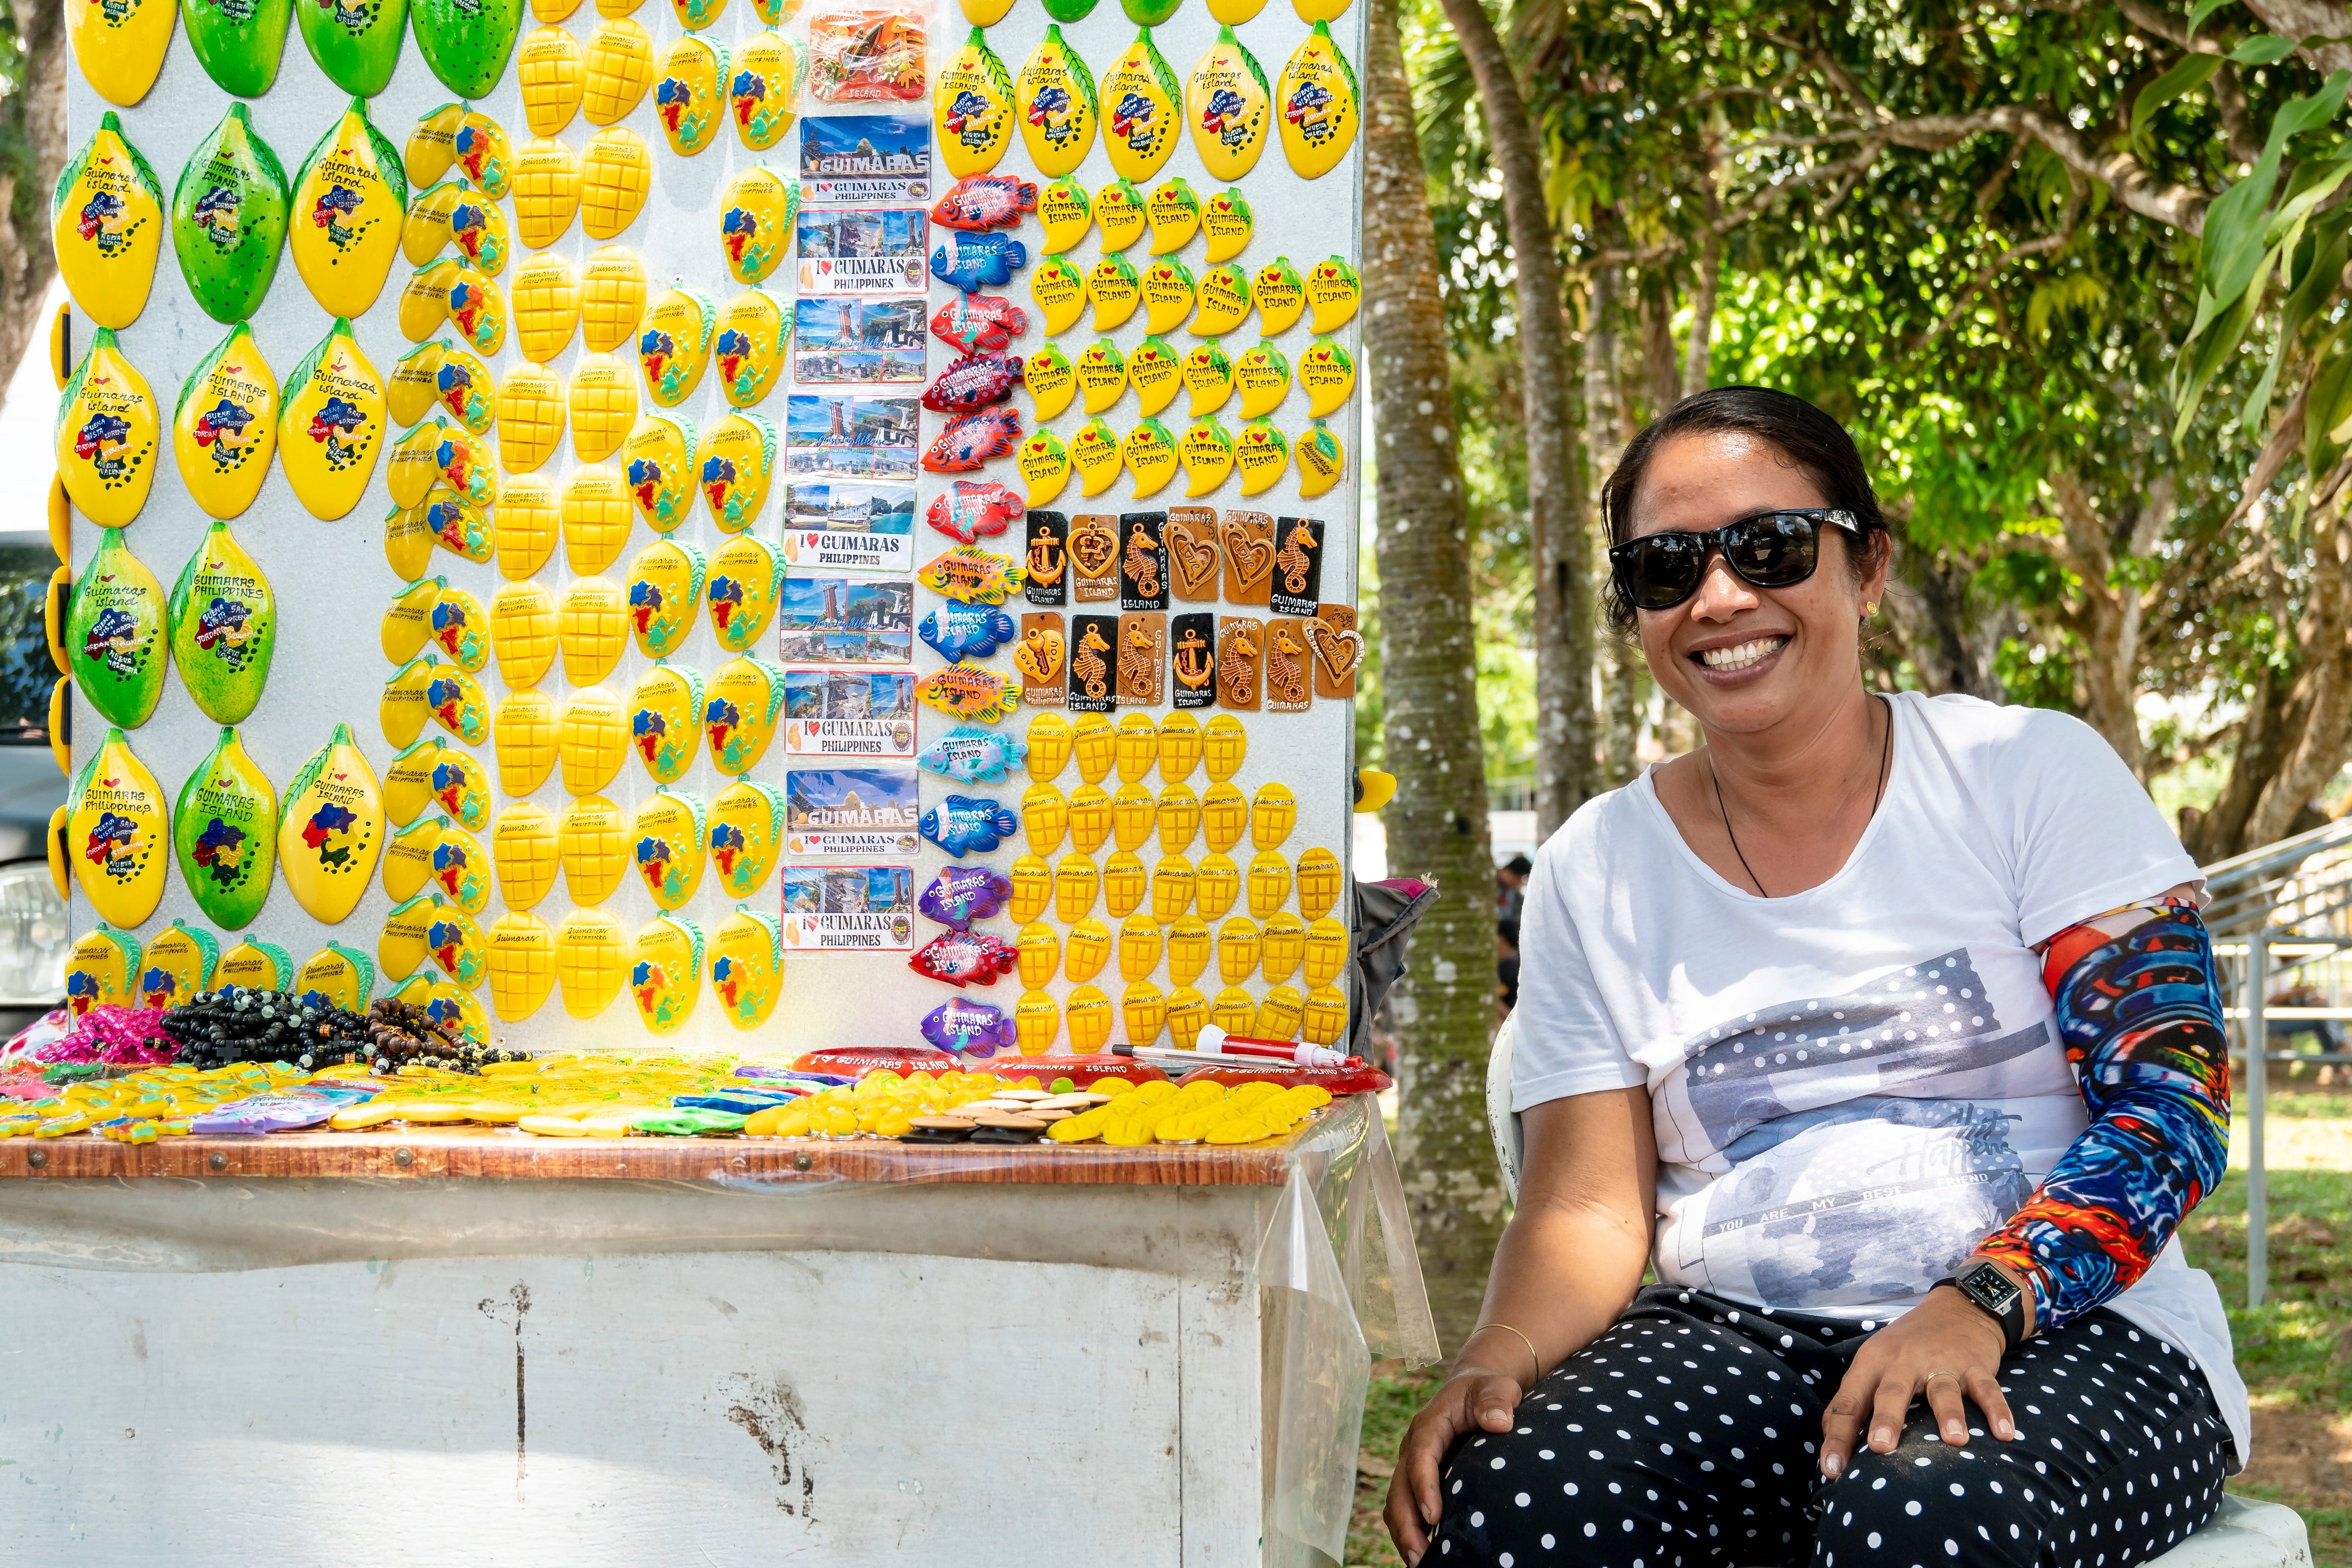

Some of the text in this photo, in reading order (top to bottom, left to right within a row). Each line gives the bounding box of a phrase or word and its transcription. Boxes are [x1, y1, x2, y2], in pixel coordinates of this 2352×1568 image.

[596, 33, 640, 44] Guimaras
[524, 43, 568, 56] Guimaras
[599, 41, 633, 50] PHILIPPINES
[528, 48, 566, 58] PHILIPPINES
[1021, 67, 1068, 77] Guimaras
[1285, 61, 1332, 74] Guimaras
[941, 71, 987, 83] GUIMARAS
[1194, 72, 1241, 82] Guimaras
[943, 83, 977, 91] ISLAND
[1285, 106, 1307, 119] JORDAN
[1049, 125, 1067, 133] NUEVA
[1306, 123, 1327, 131] NUEVA
[820, 154, 928, 171] GUIMARAS
[84, 166, 137, 184] Guimaras
[318, 158, 379, 182] Guimaras
[87, 180, 131, 193] island
[816, 183, 821, 192] I
[834, 182, 906, 192] GUIMARAS
[953, 186, 1004, 207] GUIMARAS
[961, 201, 999, 218] ISLAND
[1043, 201, 1087, 214] GUIMARAS
[1099, 202, 1143, 217] GUIMARAS
[1151, 201, 1195, 215] GUIMARAS
[1048, 213, 1081, 224] ISLAND
[1106, 216, 1137, 227] ISLAND
[1156, 213, 1190, 225] ISLAND
[1206, 214, 1250, 225] GUIMARAS
[1211, 226, 1244, 236] ISLAND
[945, 245, 997, 259] GUIMARAS
[817, 260, 821, 275] I
[835, 259, 904, 275] GUIMARAS
[948, 258, 987, 270] ISLAND
[834, 279, 893, 290] PHILIPPINES
[1036, 278, 1078, 295] GUIMARAS
[1311, 278, 1357, 291] GUIMARAS
[1044, 293, 1075, 306] ISLAND
[1316, 293, 1352, 304] ISLAND
[950, 308, 1003, 321] GUIMARAS
[951, 320, 989, 333] ISLAND
[850, 335, 896, 351] Lighthouse
[939, 361, 993, 389] GUIMARAS
[1081, 363, 1124, 375] GUIMARAS
[1304, 364, 1352, 375] GUIMARAS
[207, 373, 267, 397] GUIMARAS
[313, 370, 378, 395] Guimaras
[1088, 378, 1120, 388] ISLAND
[1309, 376, 1343, 386] ISLAND
[210, 385, 254, 403] ISLAND
[947, 376, 993, 401] ISLAND
[80, 387, 143, 404] Guimaras
[88, 401, 130, 413] island
[193, 430, 218, 438] JORDAN
[626, 426, 671, 446] Guimaras
[75, 442, 97, 452] JORDAN
[629, 435, 666, 452] PHILIPPINES
[1238, 444, 1284, 458] GUIMARAS
[97, 460, 118, 469] NUEVA
[1244, 455, 1278, 470] ISLAND
[1169, 513, 1211, 523] GUIMARAS
[1226, 511, 1268, 524] GUIMARAS
[800, 534, 899, 552] I GUIMARAS
[712, 550, 765, 561] Guimaras
[819, 553, 880, 565] PHILIPPINES
[1158, 522, 1168, 590] GUIMARAS
[944, 560, 991, 574] GUIMARAS
[194, 574, 255, 587] GUIMARAS
[944, 574, 983, 586] ISLAND
[1075, 577, 1118, 588] GUIMARAS
[194, 587, 264, 599] PHILIPPINES
[1026, 586, 1061, 596] GUIMARAS
[1084, 587, 1114, 596] ISLAND
[1031, 596, 1054, 604] ISLAND
[1122, 599, 1160, 609] ISLAND
[1271, 593, 1318, 609] GUIMARAS
[231, 605, 247, 613] SAN
[1278, 605, 1313, 615] ISLAND
[835, 616, 880, 632] Lighthouse
[1219, 620, 1258, 639] GUIMARAS
[196, 628, 222, 644] JORDAN
[1303, 625, 1324, 659] ISLAND
[1050, 640, 1058, 663] YOU
[1340, 630, 1365, 670] GUIMARAS
[1017, 649, 1035, 672] LOVE
[937, 674, 995, 689] GUIMARAS
[943, 687, 980, 700] ISLAND
[1025, 687, 1063, 699] GUIMARAS
[1175, 689, 1211, 698] GUIMARAS
[1178, 698, 1203, 706] ISLAND
[1267, 699, 1309, 710] GUIMARAS
[804, 721, 892, 737] I GUIMARAS
[822, 740, 881, 753] PHILIPPINES
[942, 738, 988, 751] GUIMARAS
[947, 750, 981, 761] ISLAND
[85, 789, 145, 801] GUIMARAS
[314, 780, 365, 798] GUIMARAS
[196, 788, 255, 810] GUIMARAS
[317, 791, 354, 805] ISLAND
[710, 796, 763, 811] Guimaras
[199, 803, 253, 822] ISLAND
[717, 802, 758, 812] PHILIPPINES
[808, 808, 918, 825] GUIMARAS
[120, 820, 135, 828] SAN
[805, 836, 808, 844] I
[823, 836, 895, 844] GUIMARAS
[87, 842, 107, 858] JORDAN
[936, 875, 985, 897] GUIMARAS
[940, 892, 975, 911] ISLAND
[803, 915, 891, 930] I GUIMARAS
[820, 935, 880, 947] PHILIPPINES
[220, 959, 267, 970] Guimaras
[223, 966, 263, 974] PHILIPPINES
[943, 1010, 993, 1026] GUIMARAS
[945, 1024, 982, 1036] ISLAND
[811, 1055, 820, 1064] I
[836, 1056, 902, 1069] GUIMARAS
[910, 1060, 949, 1070] ISLAND
[1719, 1172, 1989, 1233] YOU ARE MY BEST FRIEND
